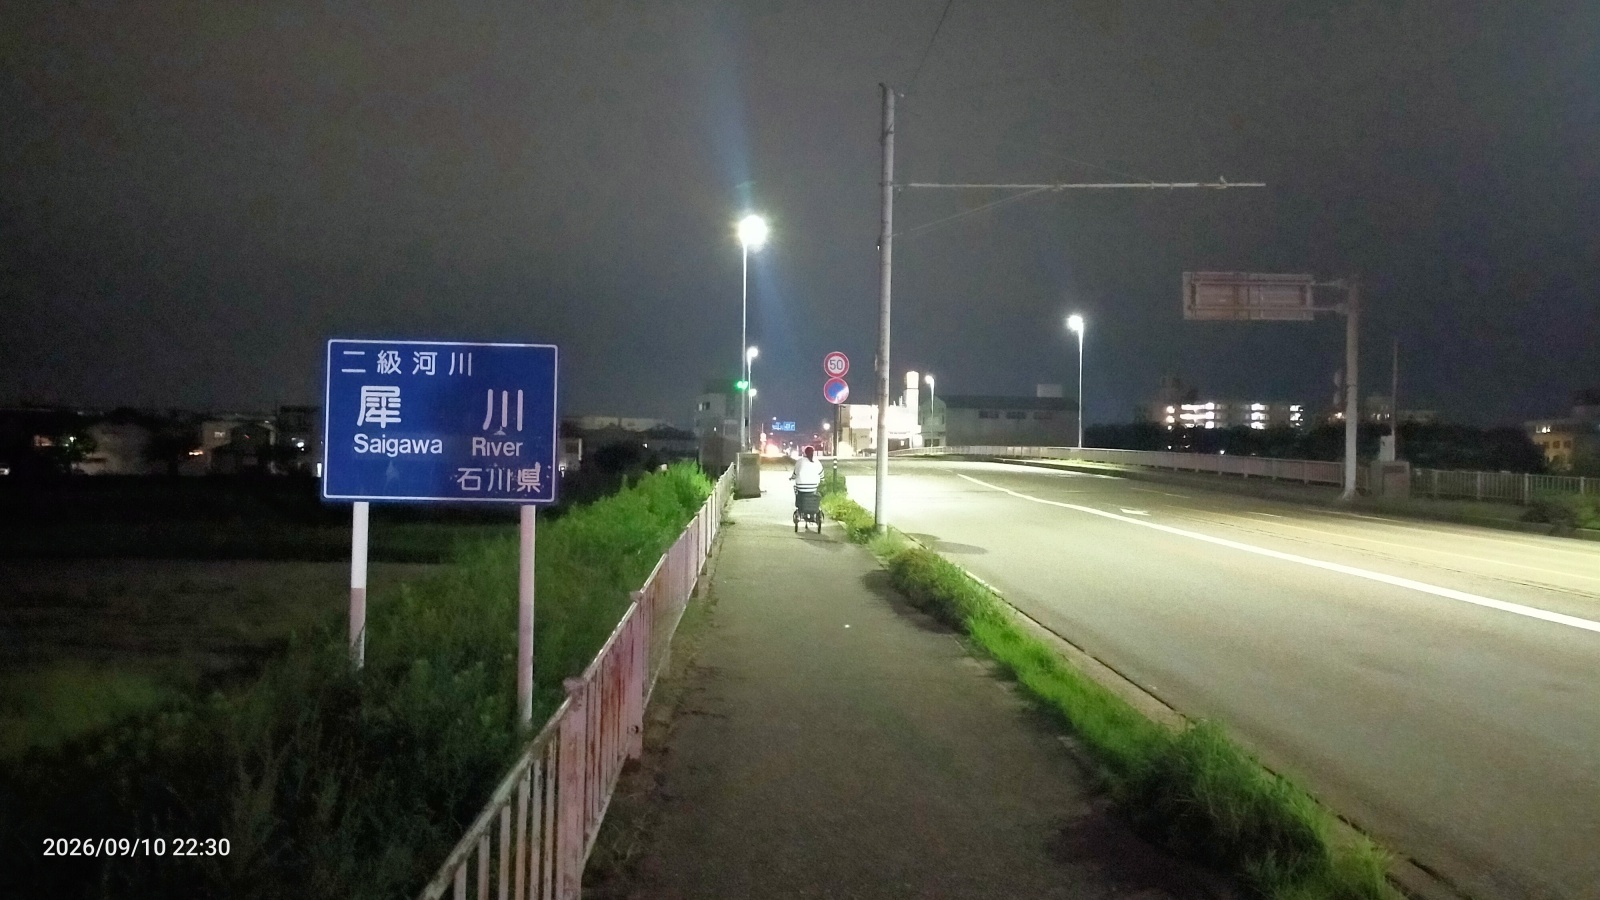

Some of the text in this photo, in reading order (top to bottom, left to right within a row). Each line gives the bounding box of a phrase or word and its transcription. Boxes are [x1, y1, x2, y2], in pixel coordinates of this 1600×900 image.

[341, 350, 472, 376] 二級河川
[829, 359, 844, 370] 50
[353, 433, 523, 457] Saigawa River
[456, 467, 541, 493] 石川県
